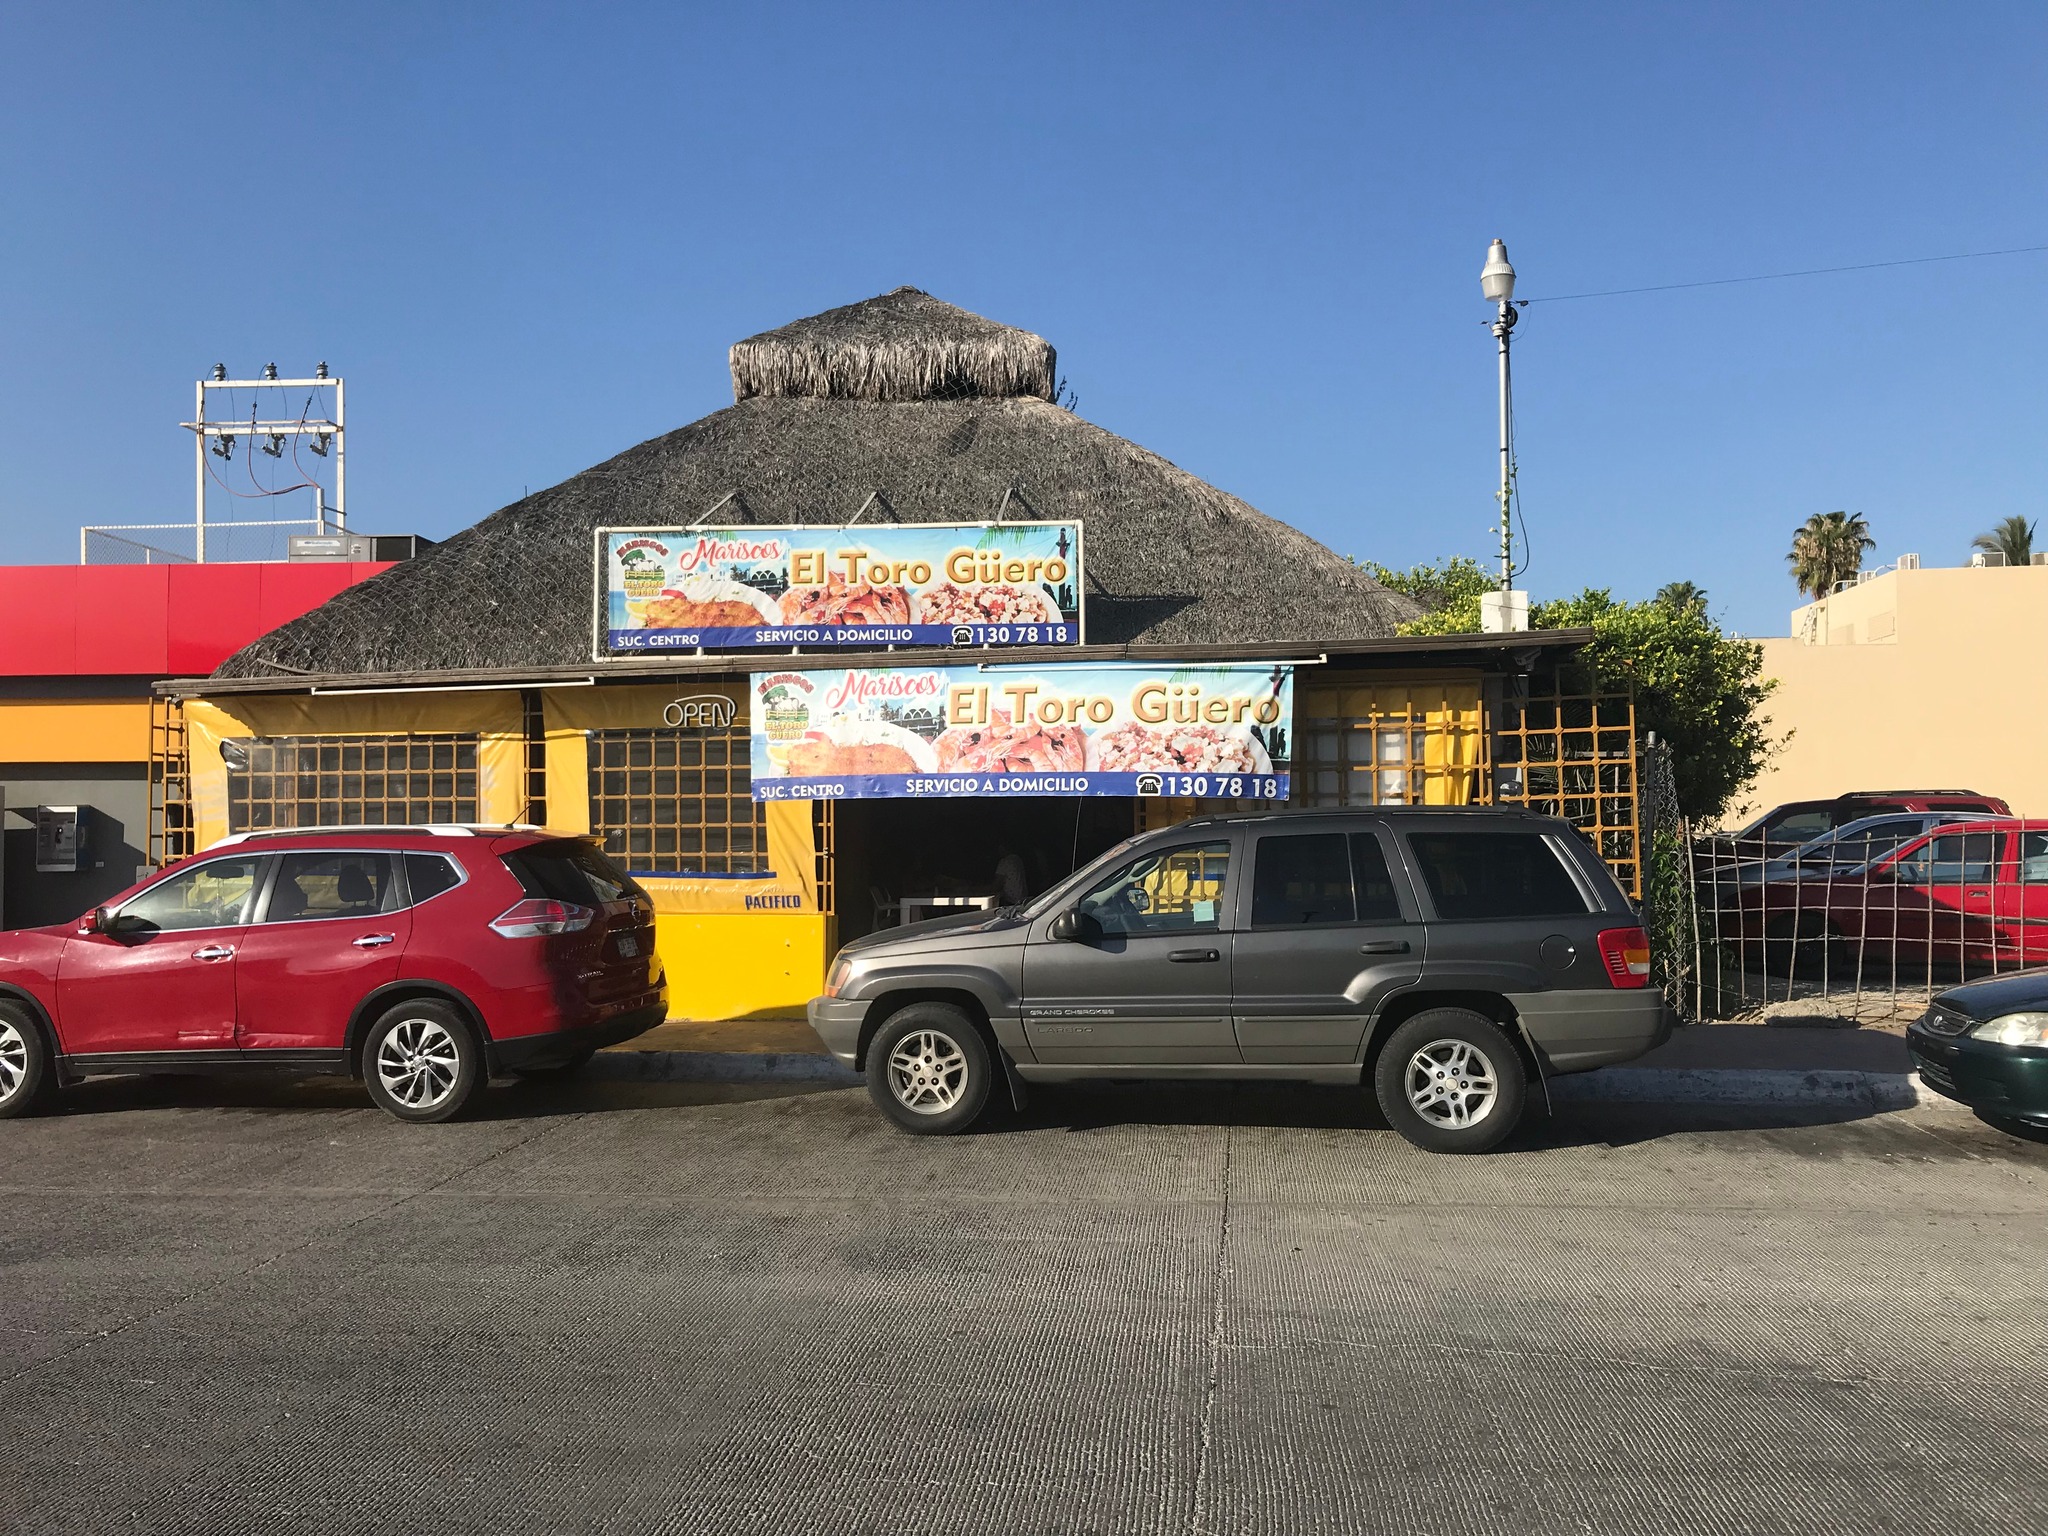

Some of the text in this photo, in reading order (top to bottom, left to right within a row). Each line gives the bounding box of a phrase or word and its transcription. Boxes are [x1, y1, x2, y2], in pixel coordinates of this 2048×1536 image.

[616, 539, 669, 558] MARISCOS
[680, 538, 783, 571] Mariscos
[792, 550, 1067, 584] El Toro Güero
[624, 581, 666, 589] EL TORO
[617, 634, 700, 647] SUC. CENTRO
[755, 628, 913, 643] SERVICIO A DOMICILIO
[977, 626, 1067, 643] 130 78 18
[757, 674, 814, 695] MARISCOS
[826, 672, 940, 708] Mariscos
[950, 685, 1280, 724] El Toro Güero
[664, 703, 731, 727] OPEN
[765, 721, 808, 731] EL TORO
[760, 783, 845, 798] SUC. CENTRO
[906, 777, 1088, 793] SERVICIO A DOMICILIO
[1167, 776, 1277, 797] 130 78 18
[745, 895, 801, 910] PACIFICO
